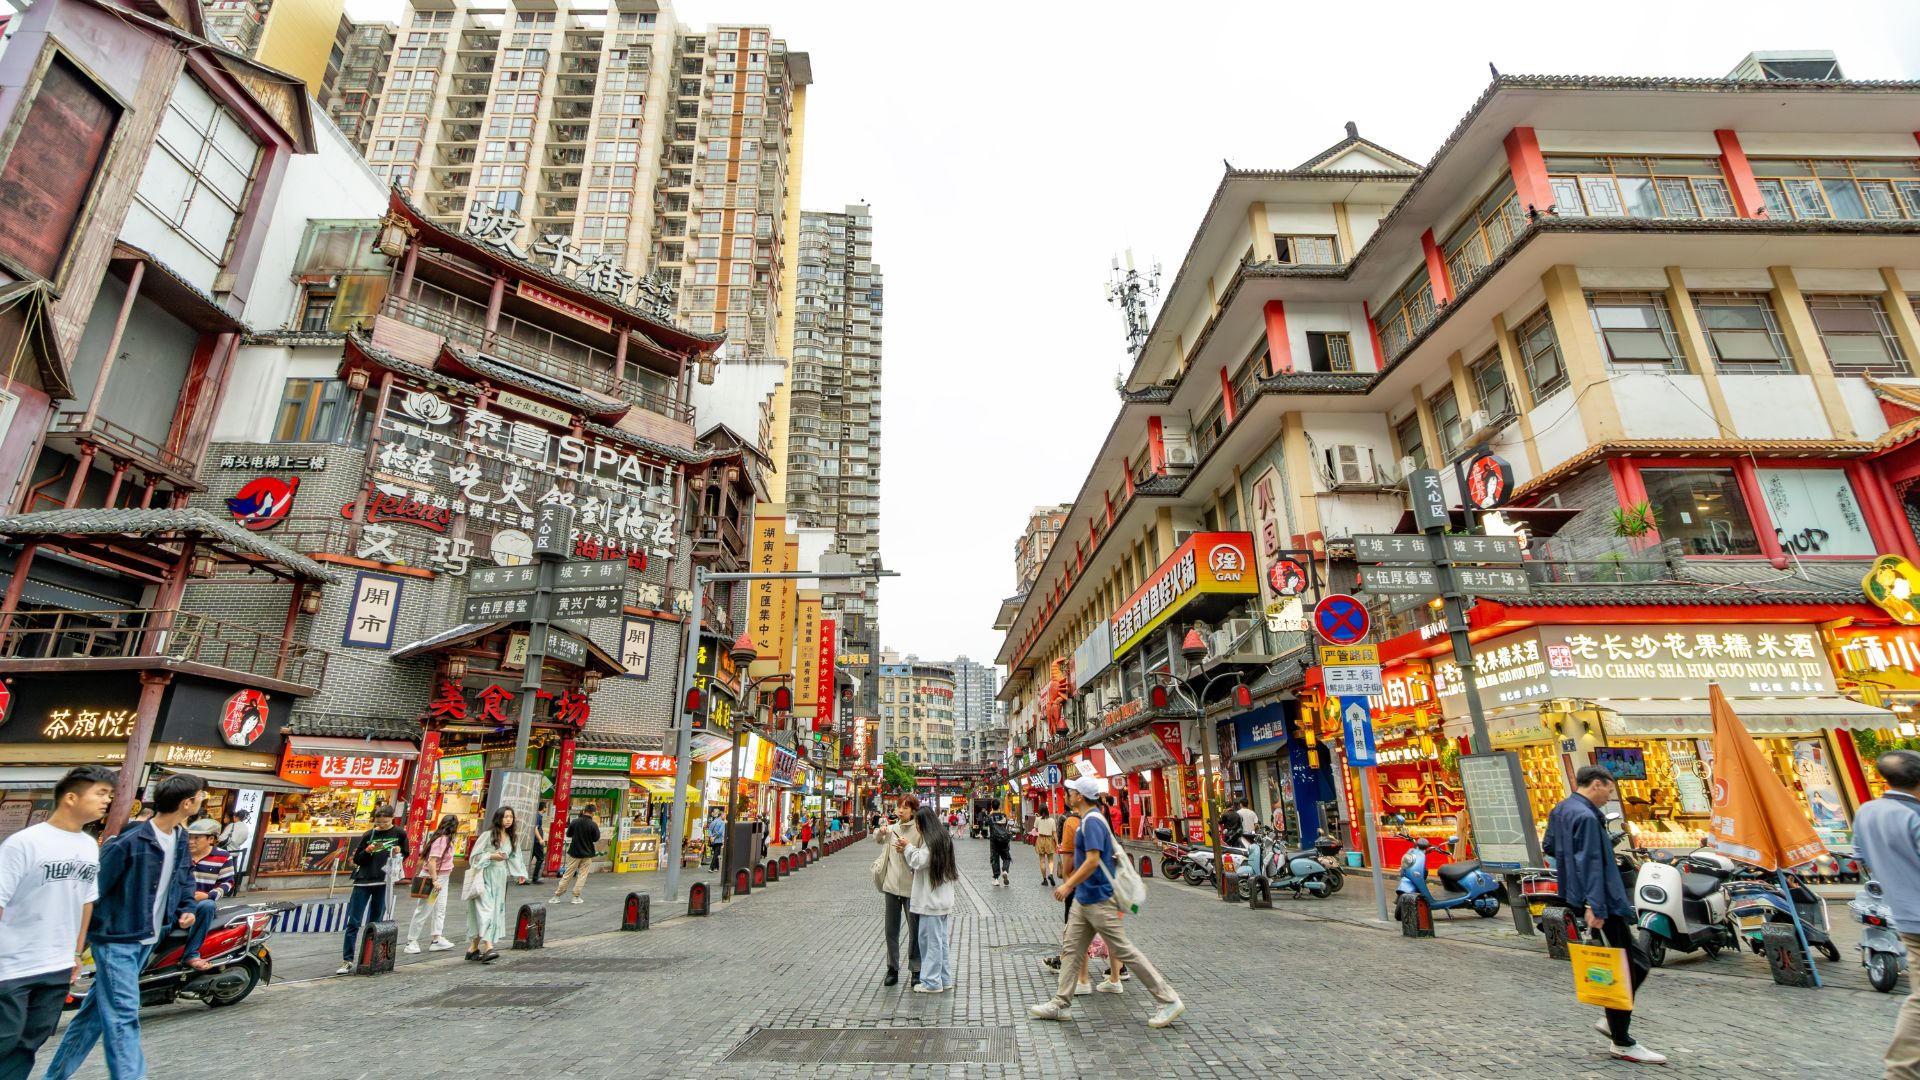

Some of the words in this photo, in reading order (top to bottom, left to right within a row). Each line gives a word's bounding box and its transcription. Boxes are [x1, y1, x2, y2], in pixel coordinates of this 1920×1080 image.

[466, 203, 635, 303] 坡子街
[638, 273, 675, 302] 美食
[635, 294, 675, 325] 广场
[220, 455, 326, 470] 两头电梯上三楼
[394, 470, 429, 485] ZHUANG
[341, 482, 452, 524] Helens
[1424, 475, 1446, 518] 天心区
[413, 489, 536, 530] 两边电梯上三楼
[537, 508, 554, 549] 天心区
[1371, 538, 1425, 552] 坡子街
[1453, 540, 1506, 553] 坡子街
[483, 568, 534, 584] 坡子街
[560, 564, 613, 578] 坡子街
[1215, 573, 1241, 581] GAN
[1376, 570, 1434, 585] 伍厚德堂
[1460, 571, 1515, 586] 黄兴广场
[757, 526, 776, 650] 湖南名吃匯集中心
[480, 599, 528, 616] 伍厚德堂
[558, 594, 608, 611] 黄兴广场
[1565, 632, 1816, 660] 老长沙花果糯米酒
[1325, 649, 1375, 662] 严管路段
[1439, 639, 1540, 683] 老花果糯米酒
[1331, 669, 1373, 681] 三王街
[1575, 663, 1603, 679] LAO
[1605, 663, 1655, 679] CHANG
[1657, 663, 1686, 679] SHA
[1688, 663, 1717, 679] HUA
[1717, 663, 1745, 679] GUO
[1745, 663, 1778, 679] NUO
[1779, 663, 1799, 679] MI
[1799, 663, 1822, 681] JIU
[1163, 727, 1180, 738] 24
[1352, 711, 1364, 750] 单行路
[324, 756, 400, 776] 烤肥肠
